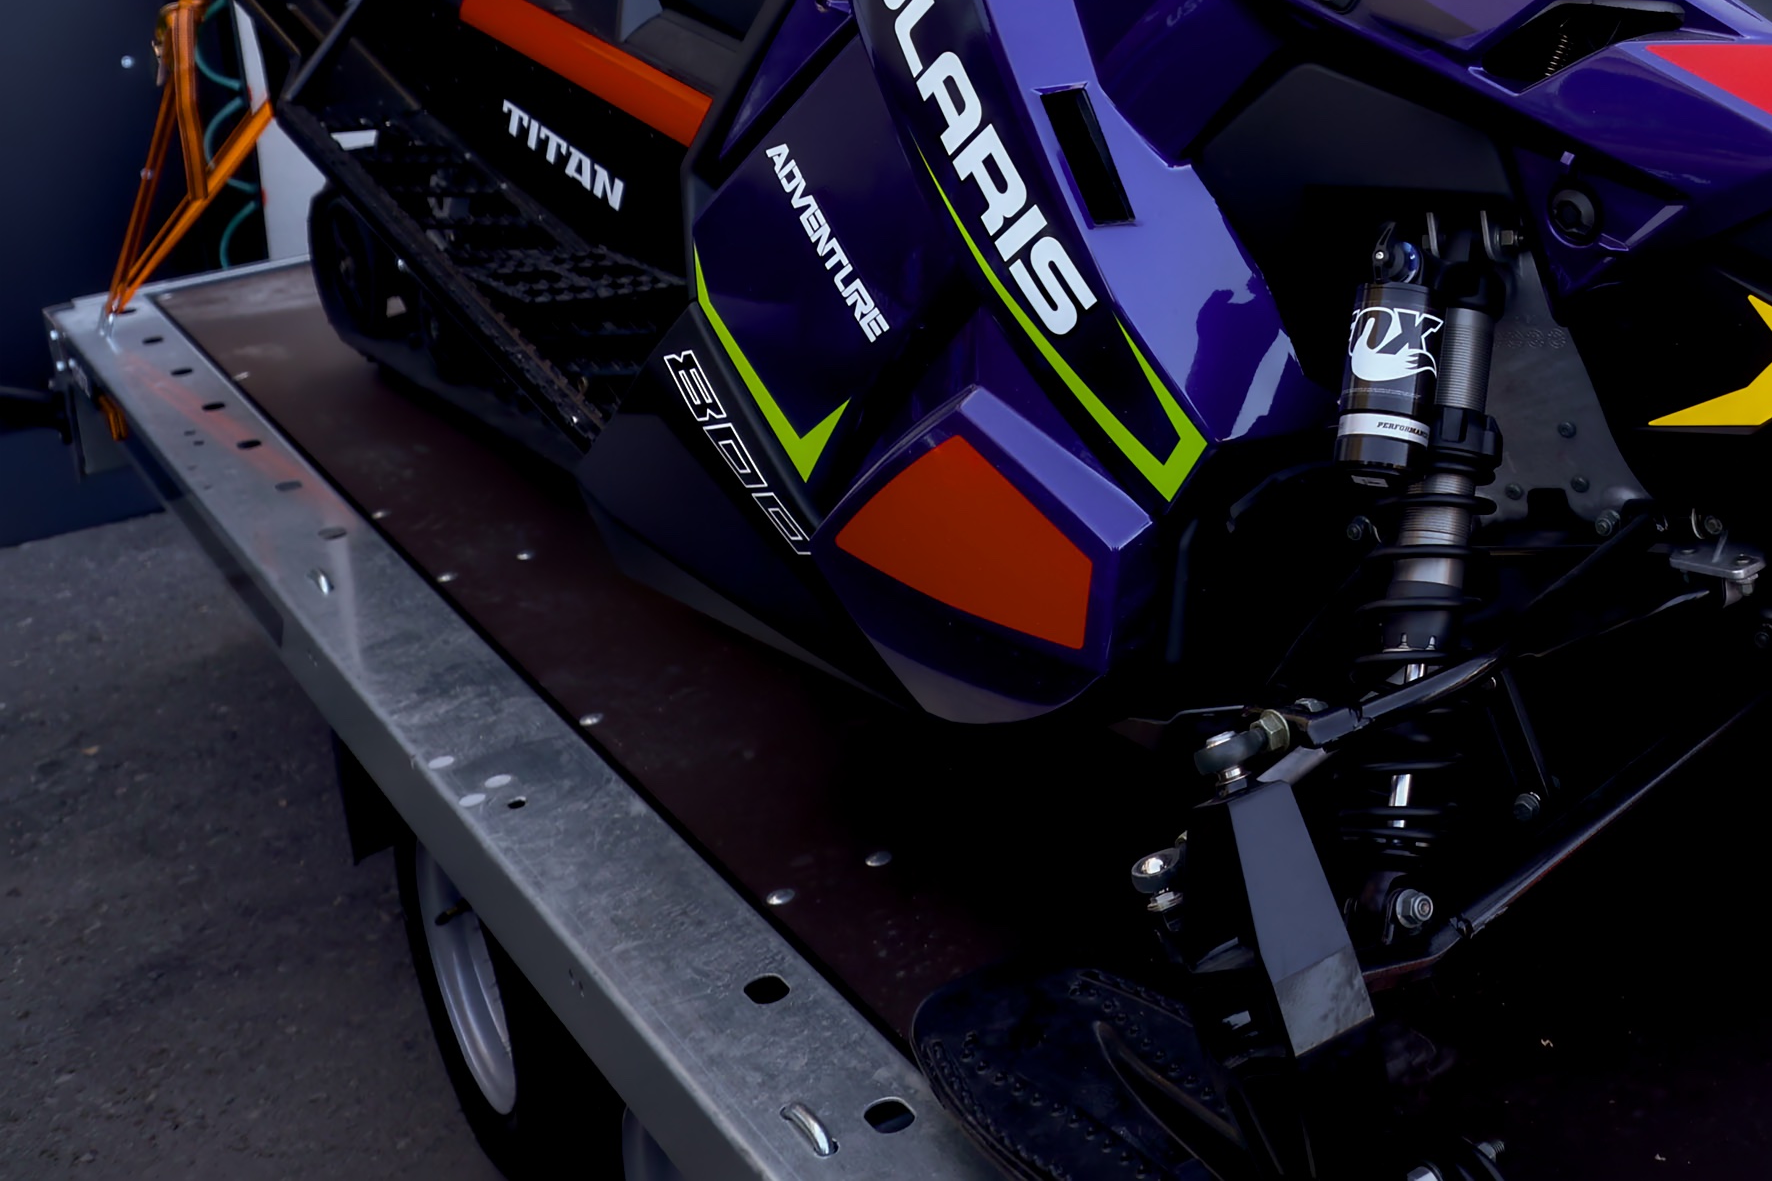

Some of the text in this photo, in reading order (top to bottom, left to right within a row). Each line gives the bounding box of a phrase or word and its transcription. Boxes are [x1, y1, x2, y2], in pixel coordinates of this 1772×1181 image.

[502, 98, 625, 212] TITAN
[765, 143, 891, 343] ADVENTURE
[1348, 306, 1444, 358] OX
